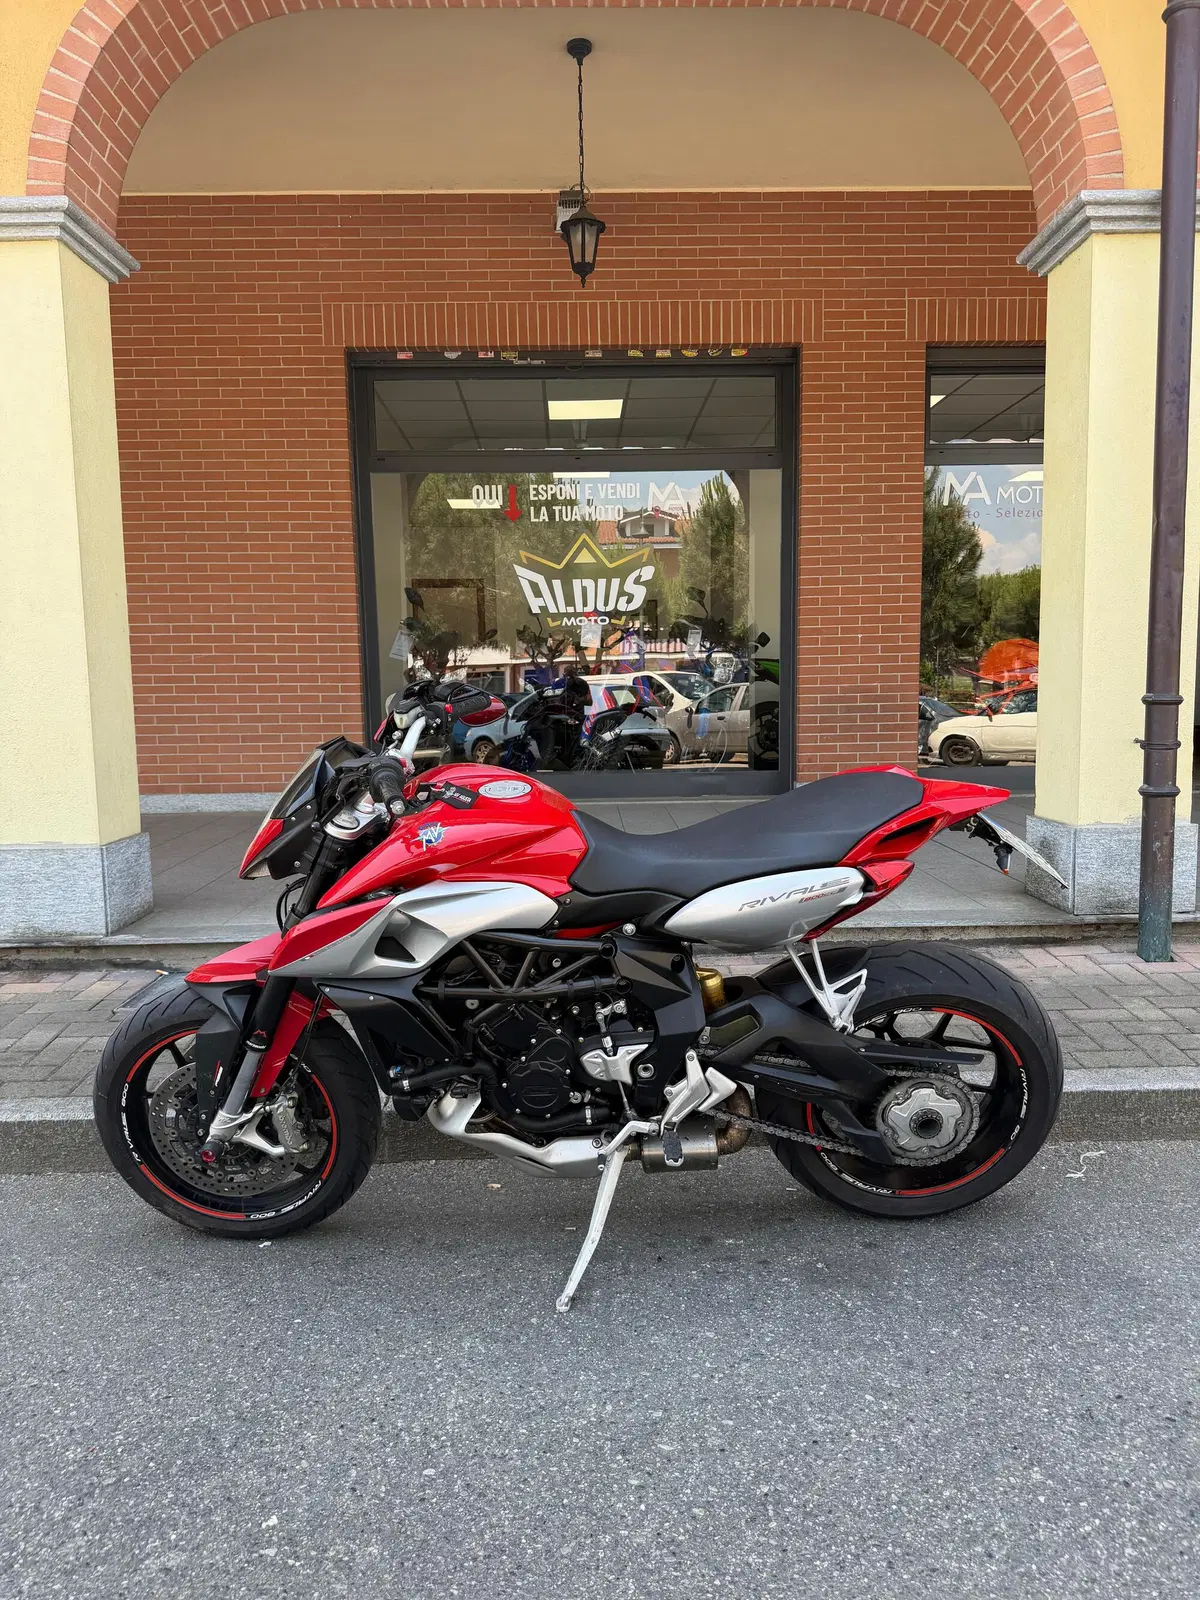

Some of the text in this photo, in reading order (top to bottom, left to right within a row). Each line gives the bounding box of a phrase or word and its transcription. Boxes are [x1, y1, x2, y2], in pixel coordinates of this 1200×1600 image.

[472, 484, 503, 507] QUI
[529, 483, 640, 500] ESPONI E VENDI
[530, 504, 624, 523] LA TUA MOTO
[513, 563, 655, 614] ALDUS
[561, 616, 610, 626] MOTO
[738, 876, 850, 911] RIVALE
